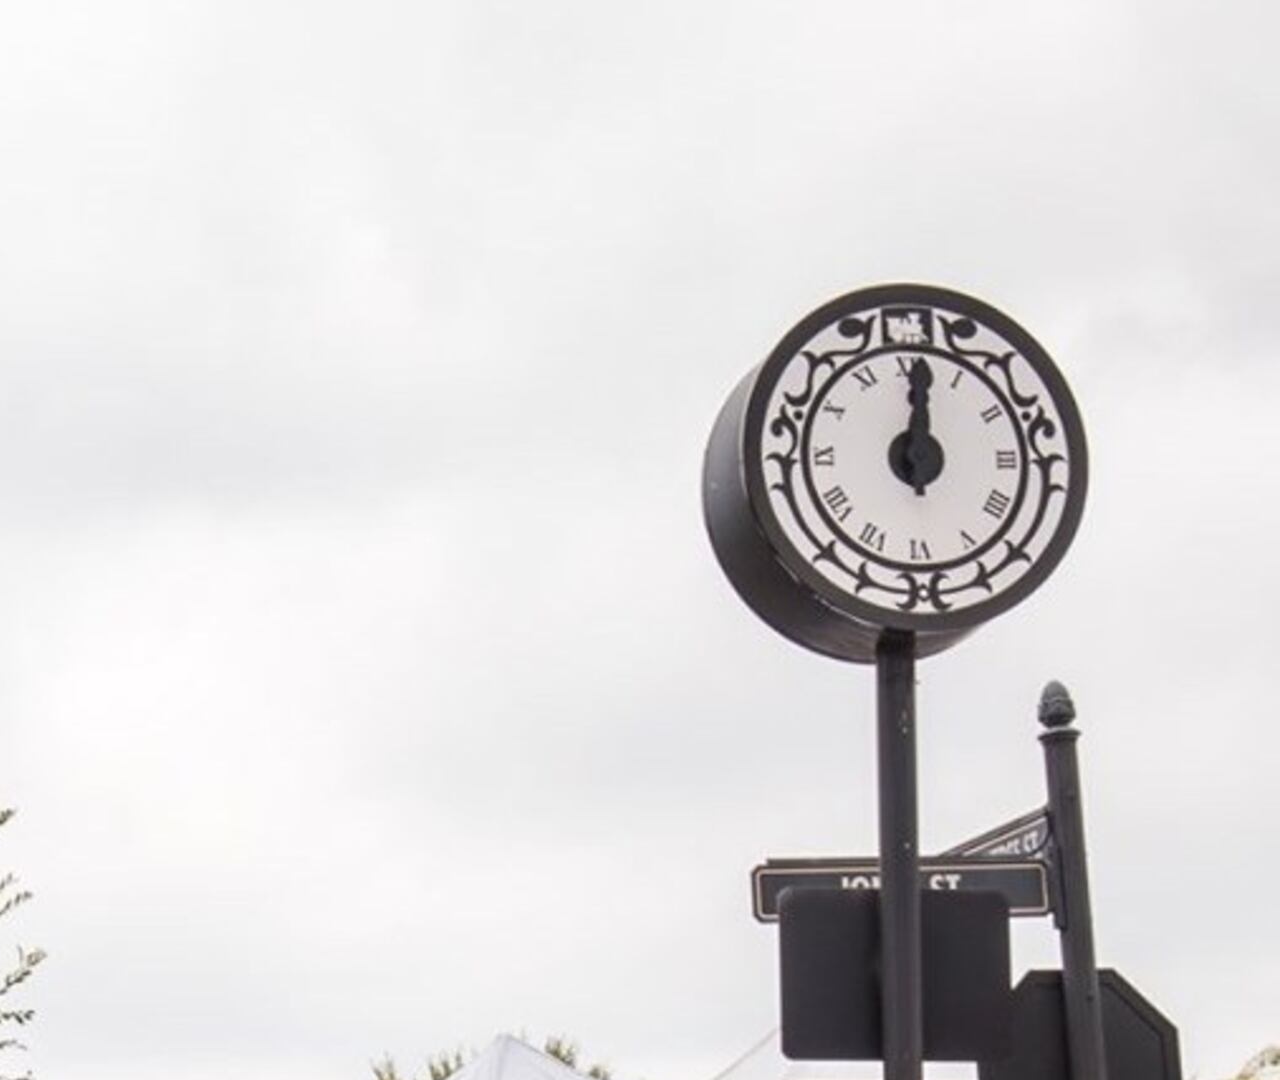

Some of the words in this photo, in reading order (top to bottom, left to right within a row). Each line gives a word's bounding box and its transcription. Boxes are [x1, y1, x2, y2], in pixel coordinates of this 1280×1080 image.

[823, 401, 845, 420] X
[980, 404, 1003, 424] II
[814, 446, 835, 467] IX
[996, 449, 1017, 470] III
[909, 539, 932, 560] VI
[959, 530, 976, 549] V
